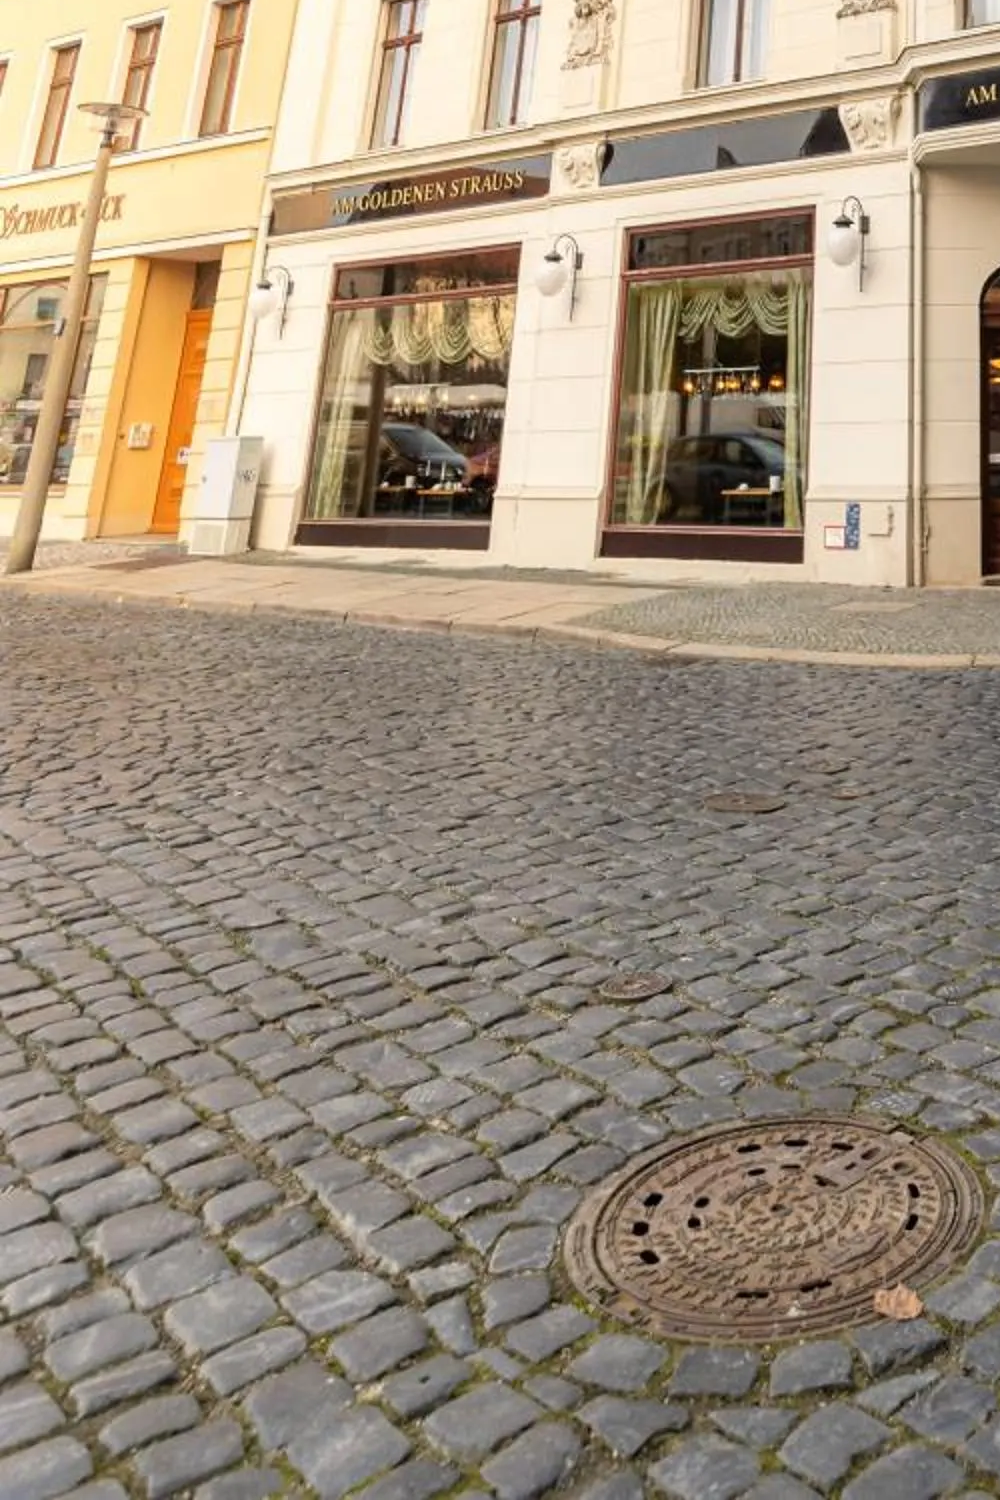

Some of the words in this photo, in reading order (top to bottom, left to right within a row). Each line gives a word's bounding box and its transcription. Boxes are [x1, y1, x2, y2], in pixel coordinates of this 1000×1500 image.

[963, 83, 998, 108] AM
[331, 194, 353, 216] AM
[356, 179, 447, 213] GOLDENEN
[450, 167, 526, 199] STRAUSS
